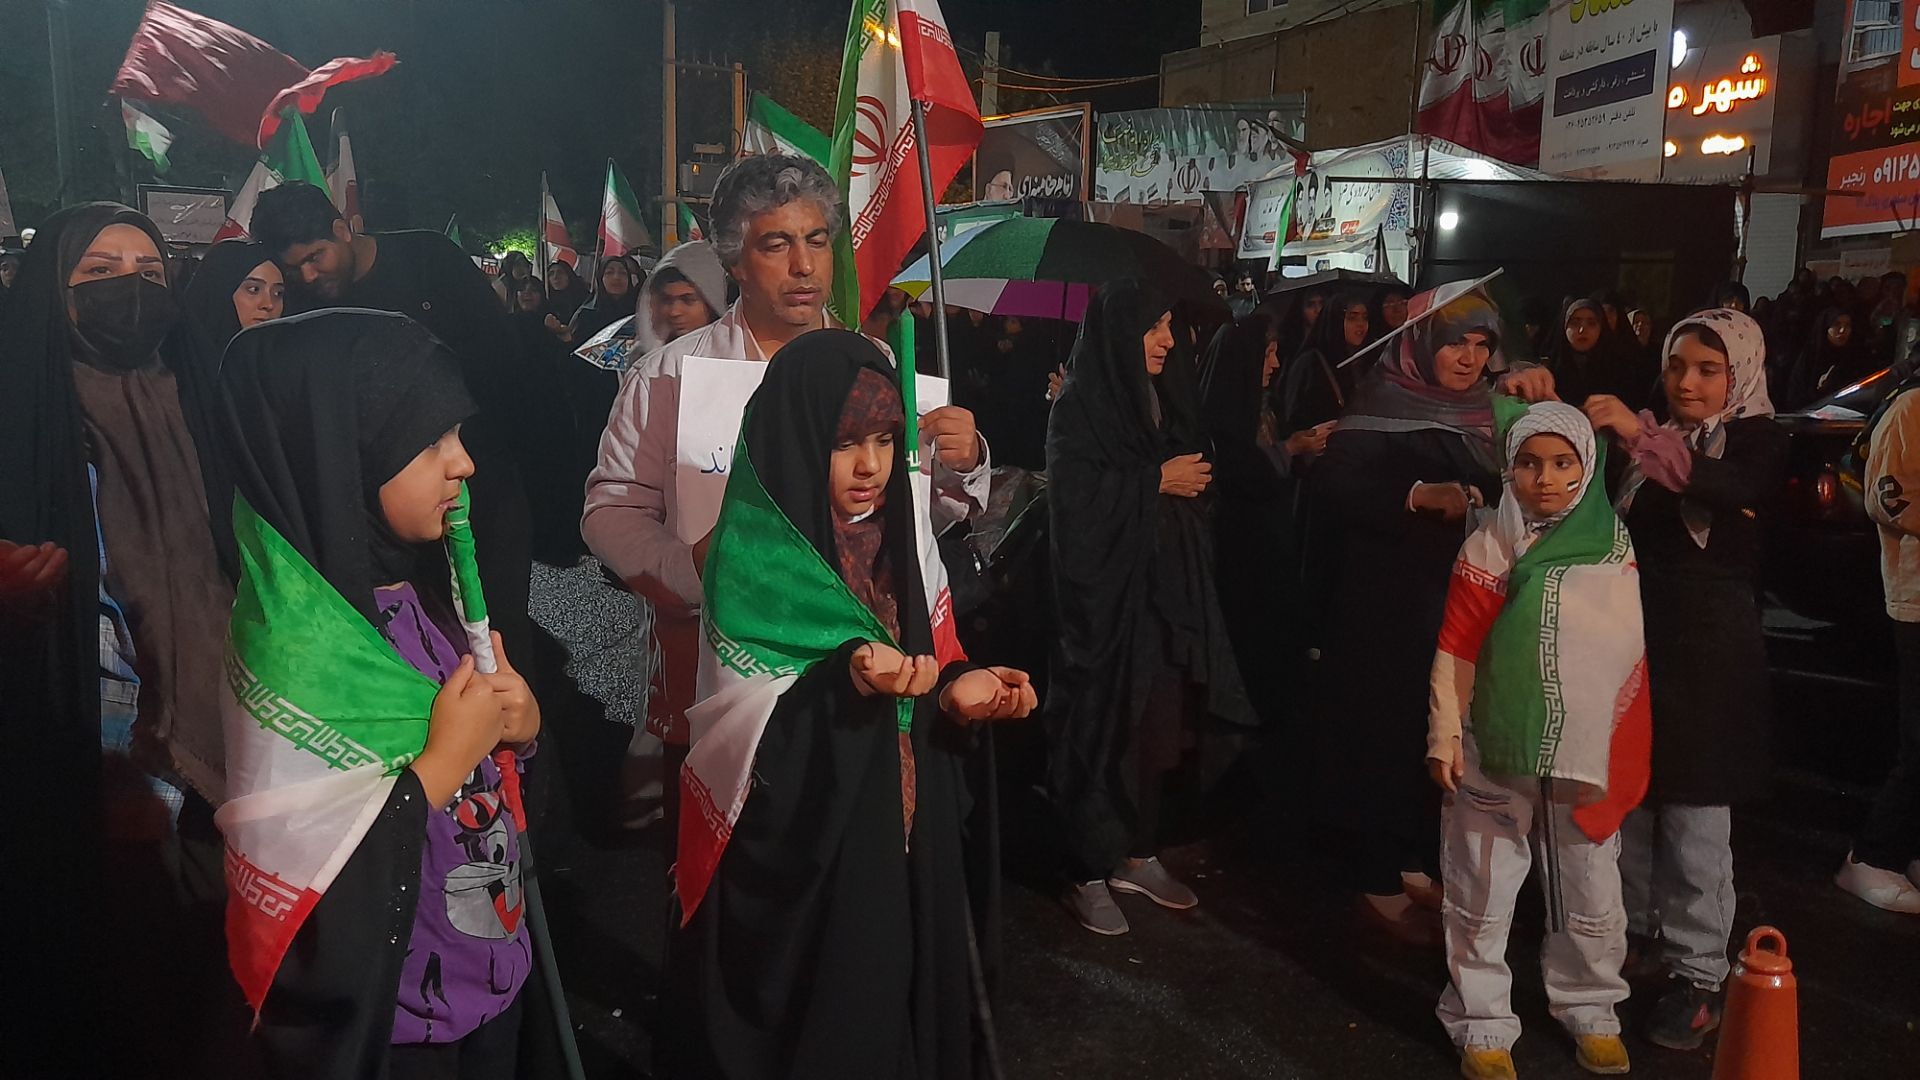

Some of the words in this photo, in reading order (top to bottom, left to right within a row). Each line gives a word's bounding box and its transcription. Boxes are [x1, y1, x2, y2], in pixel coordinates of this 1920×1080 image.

[1693, 54, 1766, 115] شهر
[1844, 99, 1892, 140] اجاره
[1892, 99, 1912, 113] جهت
